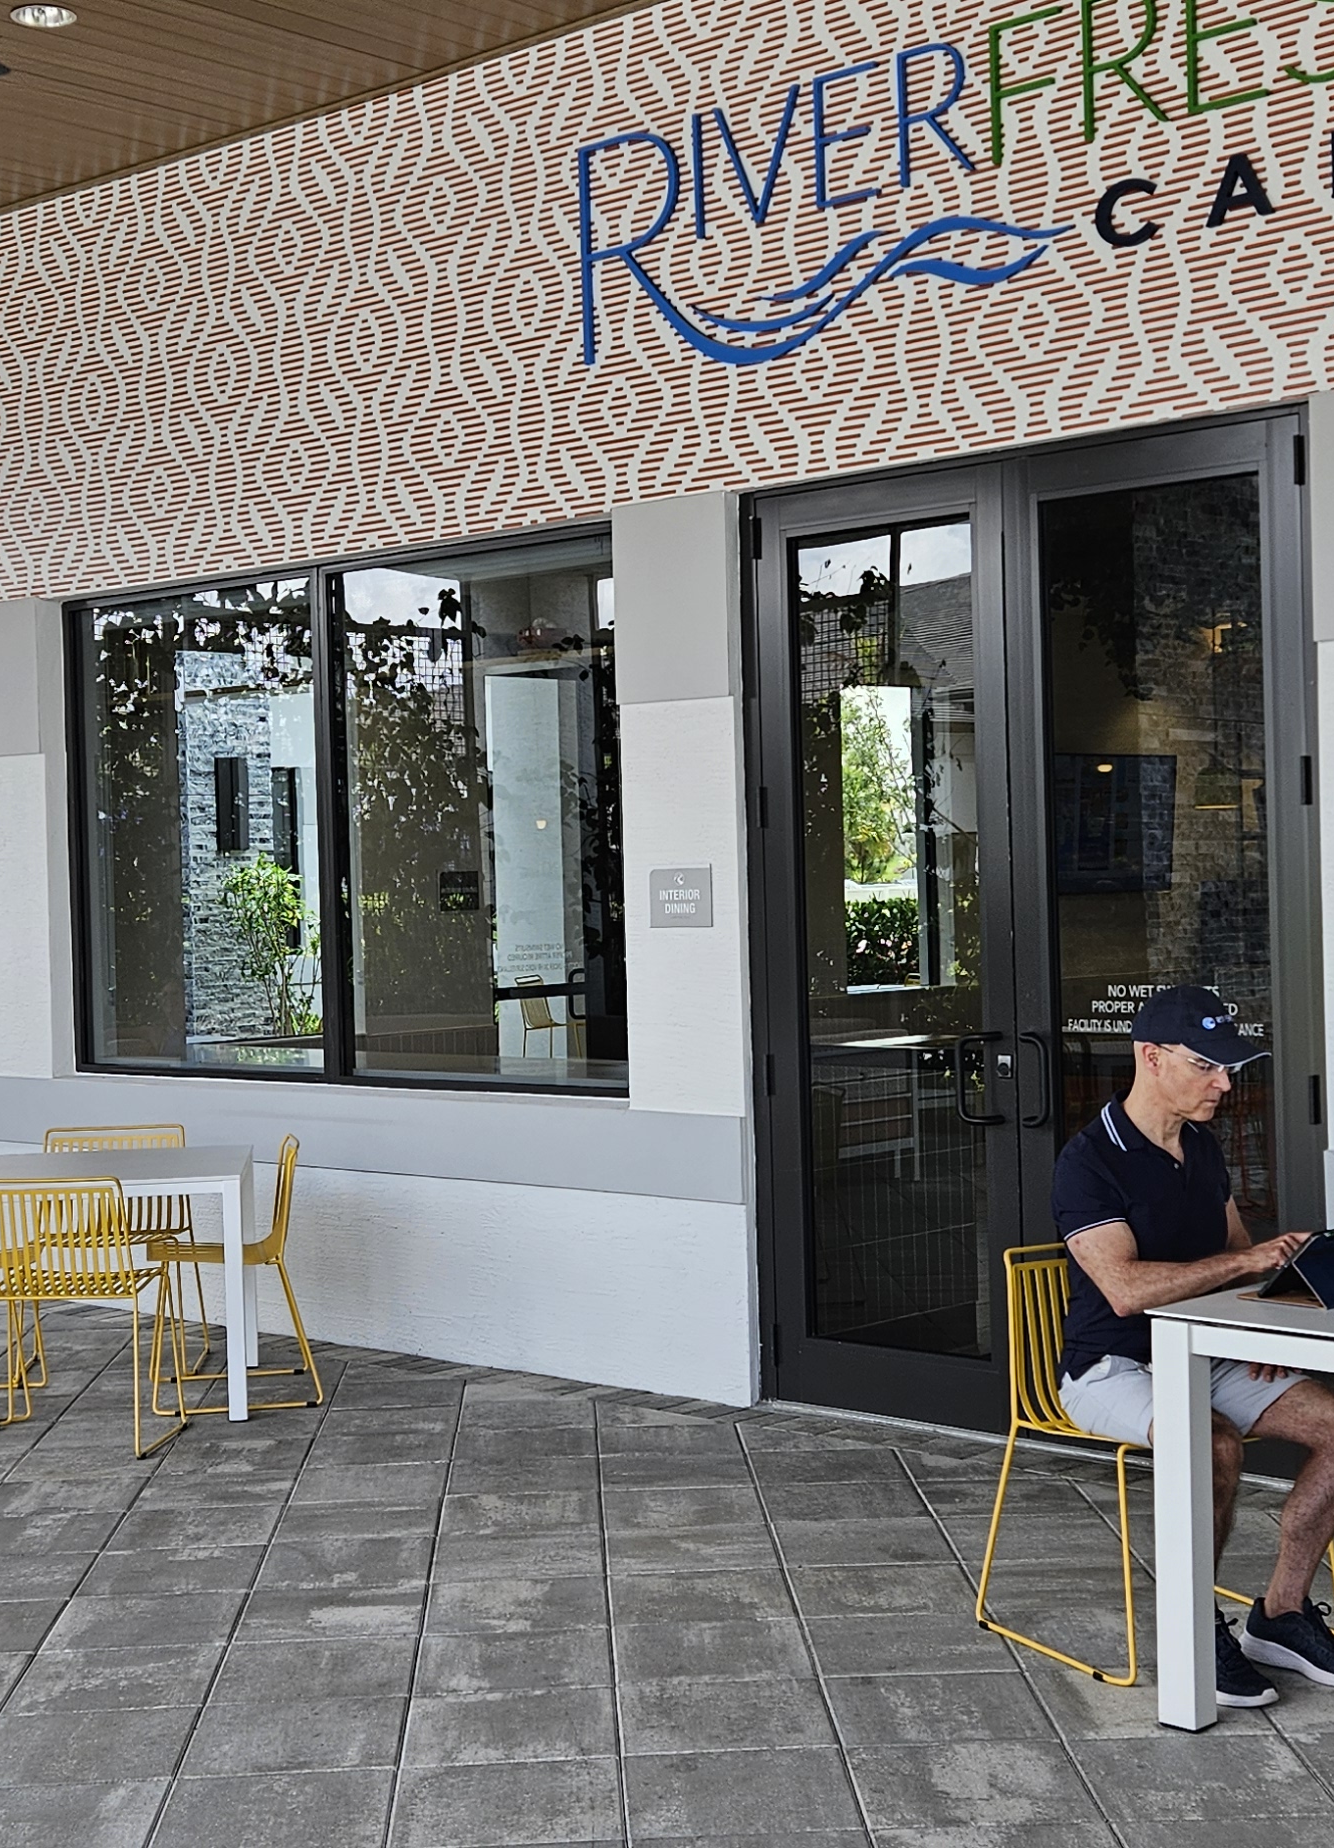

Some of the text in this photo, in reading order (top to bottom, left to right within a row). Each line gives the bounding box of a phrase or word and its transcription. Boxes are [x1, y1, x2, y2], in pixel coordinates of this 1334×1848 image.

[659, 889, 700, 901] INTERIOR
[665, 903, 696, 914] DINING
[1107, 984, 1126, 997] NO
[1129, 984, 1154, 998] WET
[1091, 1000, 1135, 1013] PROPER
[1104, 1019, 1112, 1032] IS
[1113, 1020, 1133, 1033] UND
